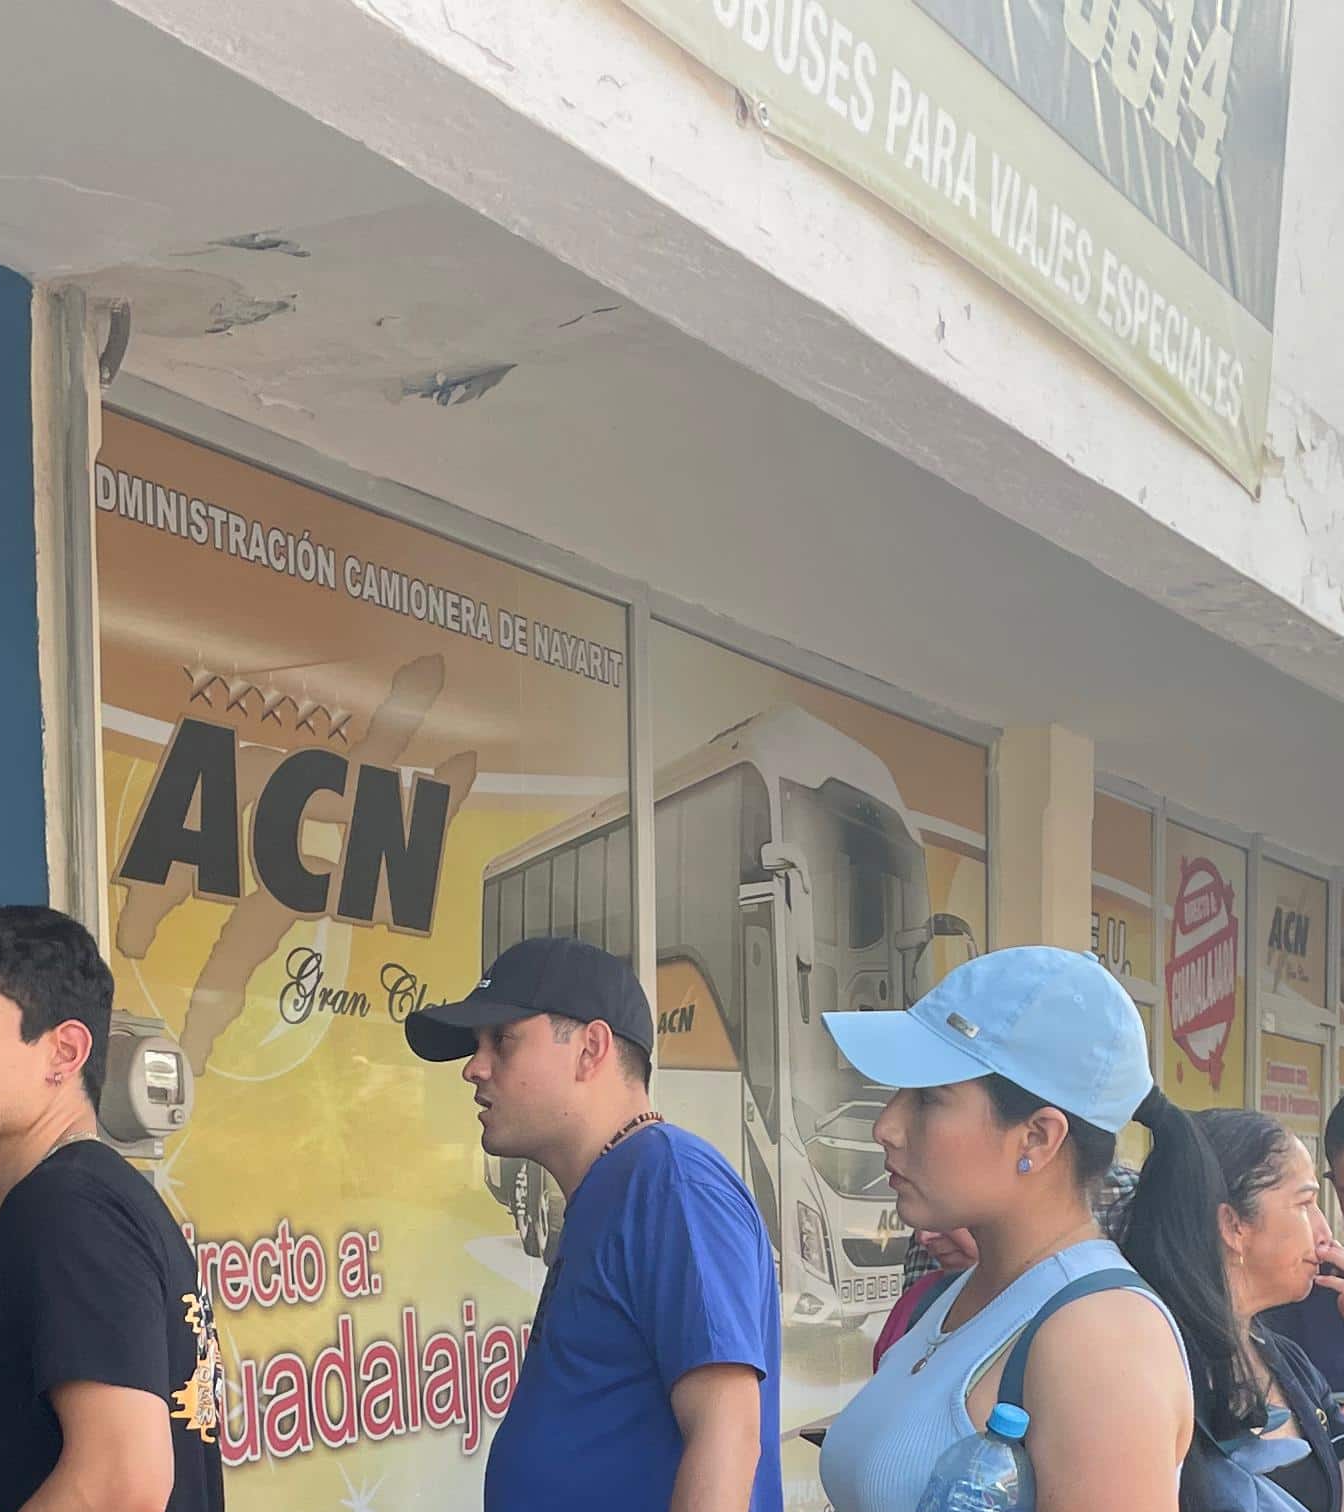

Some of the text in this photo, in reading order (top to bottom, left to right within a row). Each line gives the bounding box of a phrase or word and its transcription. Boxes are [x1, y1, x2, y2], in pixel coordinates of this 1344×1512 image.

[886, 68, 978, 219] PARA
[990, 152, 1094, 306] VIAJES
[1097, 247, 1245, 429] ESPECIALES
[343, 555, 493, 643] CAMIONERA
[499, 609, 528, 654] DE
[534, 621, 624, 687] NAYARIT
[116, 716, 452, 934] ACN
[1268, 906, 1310, 958] ACN
[280, 947, 370, 1025] Gran
[656, 1003, 696, 1036] ACN
[183, 1217, 384, 1311] recto a:
